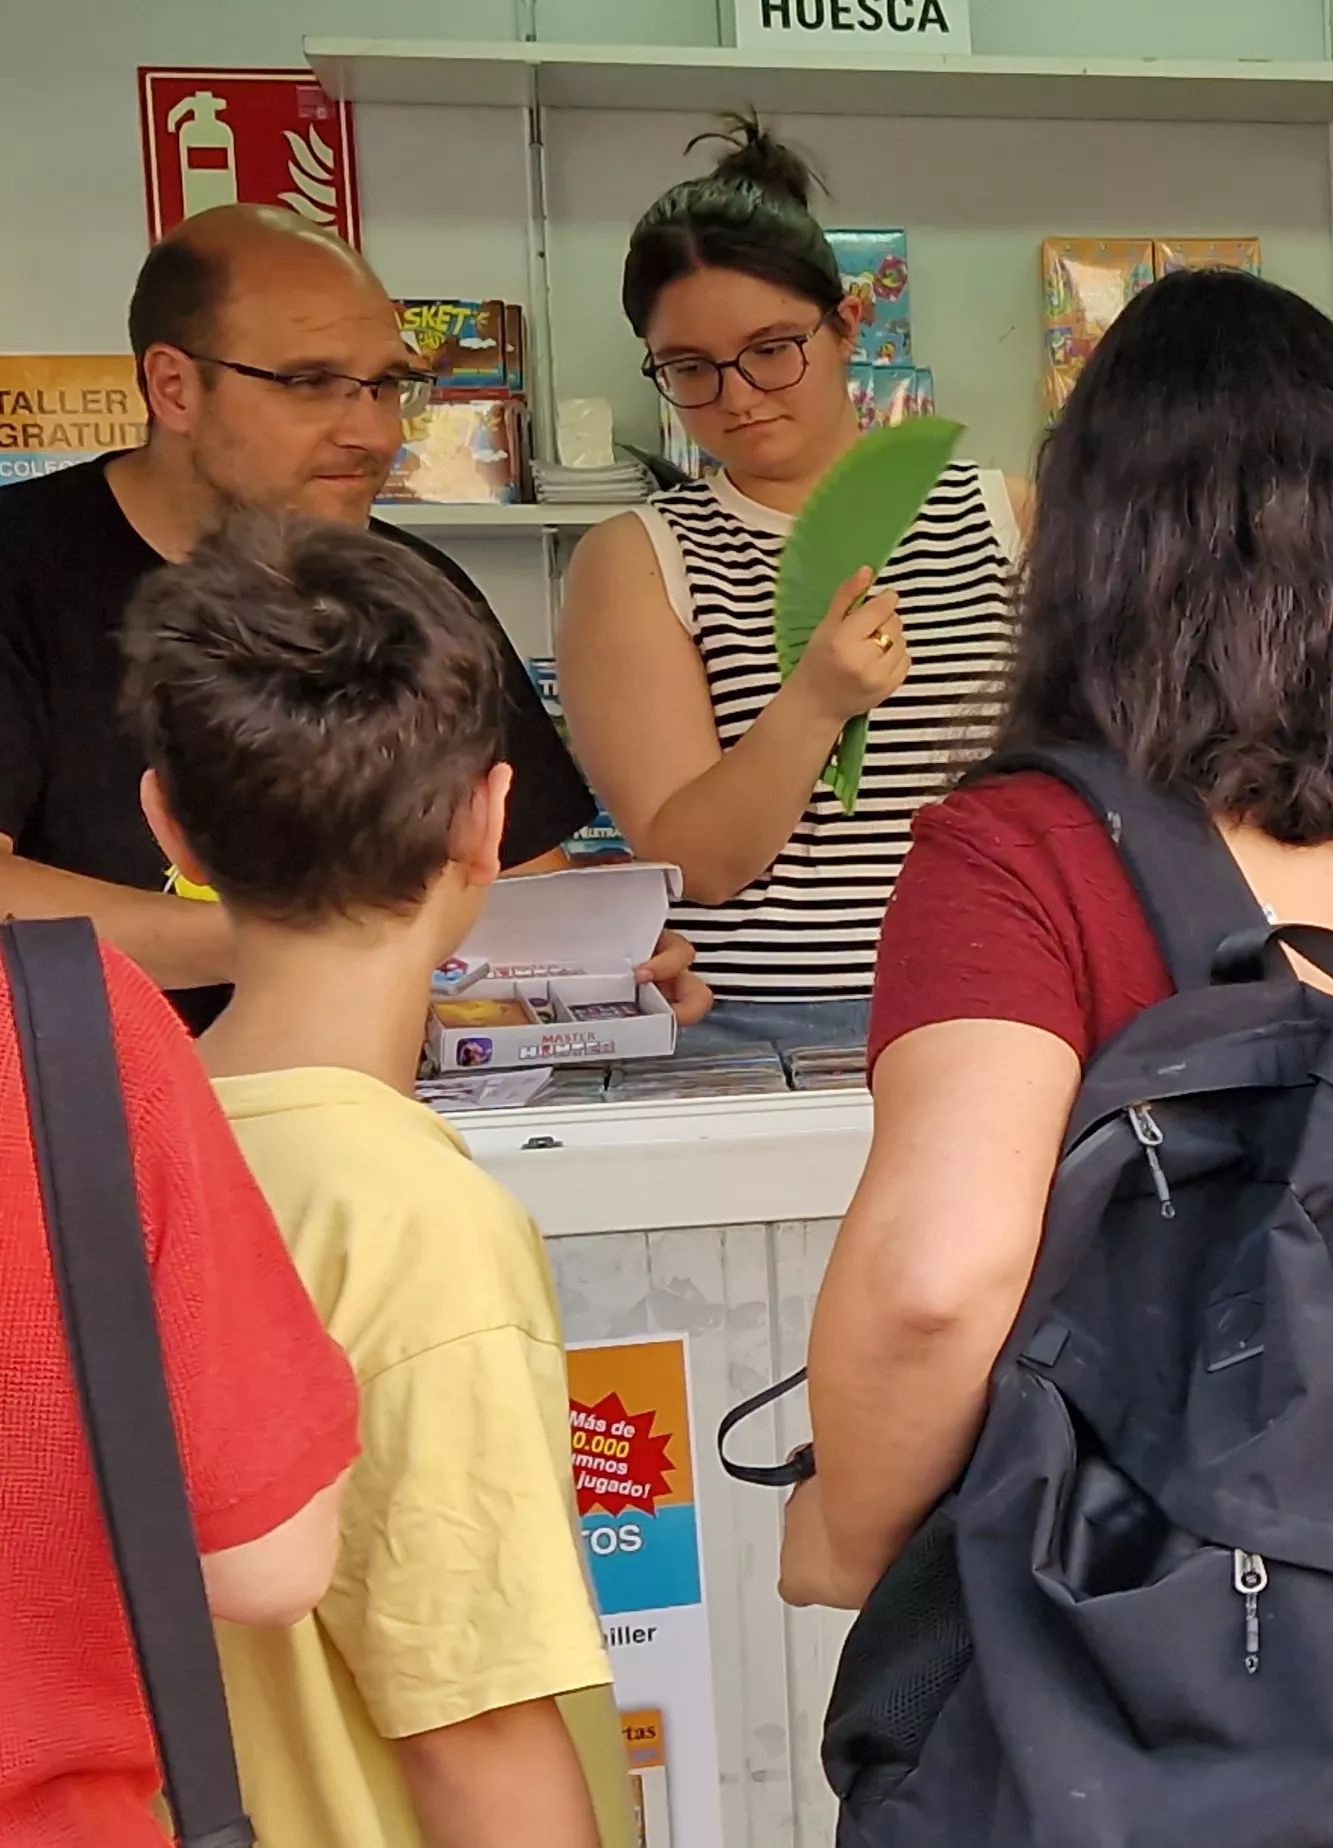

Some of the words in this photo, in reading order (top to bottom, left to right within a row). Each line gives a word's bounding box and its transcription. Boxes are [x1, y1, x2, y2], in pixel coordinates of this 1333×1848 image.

[762, 0, 950, 33] HUESCA
[0, 390, 128, 415] TALLER
[570, 1410, 607, 1433] Más
[611, 1420, 636, 1438] de
[576, 1470, 652, 1499] jugado!
[581, 1524, 643, 1555] OS
